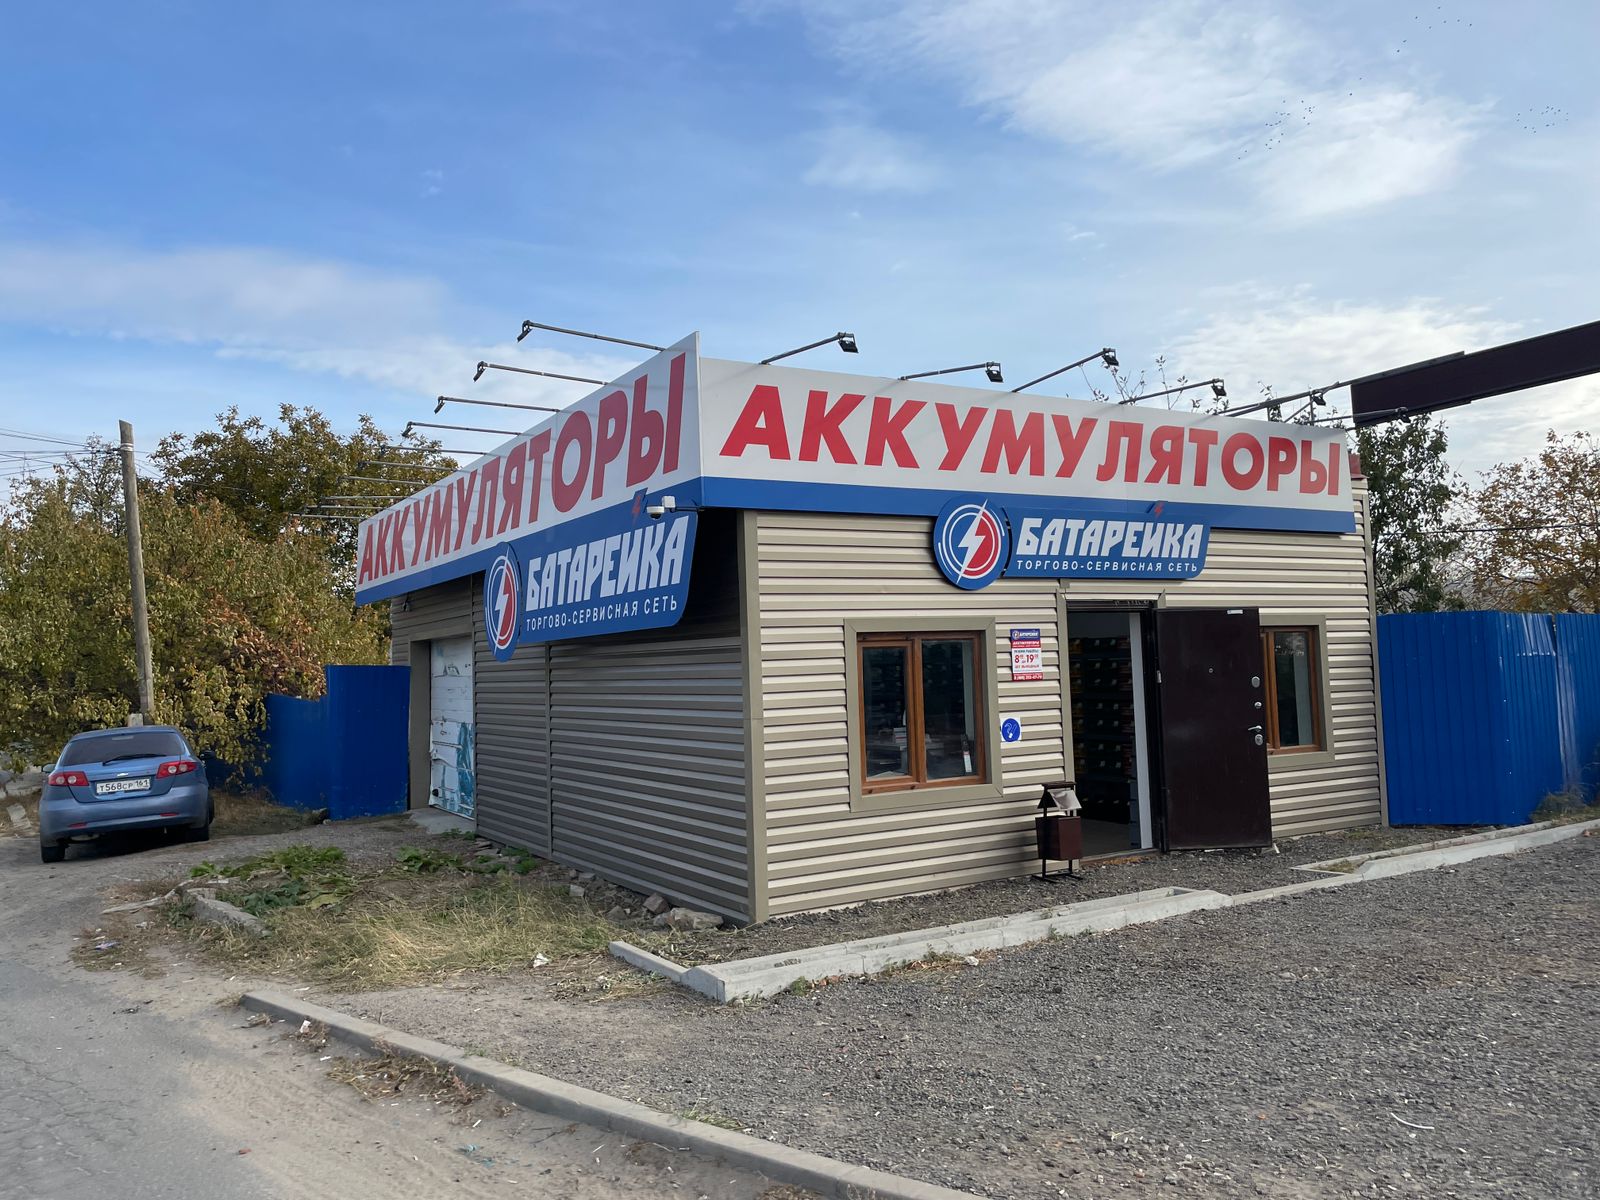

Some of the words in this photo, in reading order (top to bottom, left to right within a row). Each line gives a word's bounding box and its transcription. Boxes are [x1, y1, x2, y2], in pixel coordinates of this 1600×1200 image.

[358, 352, 686, 585] АККУМУЛЯТОРЫ
[719, 385, 1340, 496] АККУМУЛЯТОРЫ
[1017, 560, 1162, 572] ТОРГОВО-СЕРВИСНАЯ
[1168, 563, 1198, 572] СЕТЬ
[526, 599, 638, 631] ТОРГОВО-СЕРВИСНАЯ
[644, 594, 678, 614] СЕТЬ
